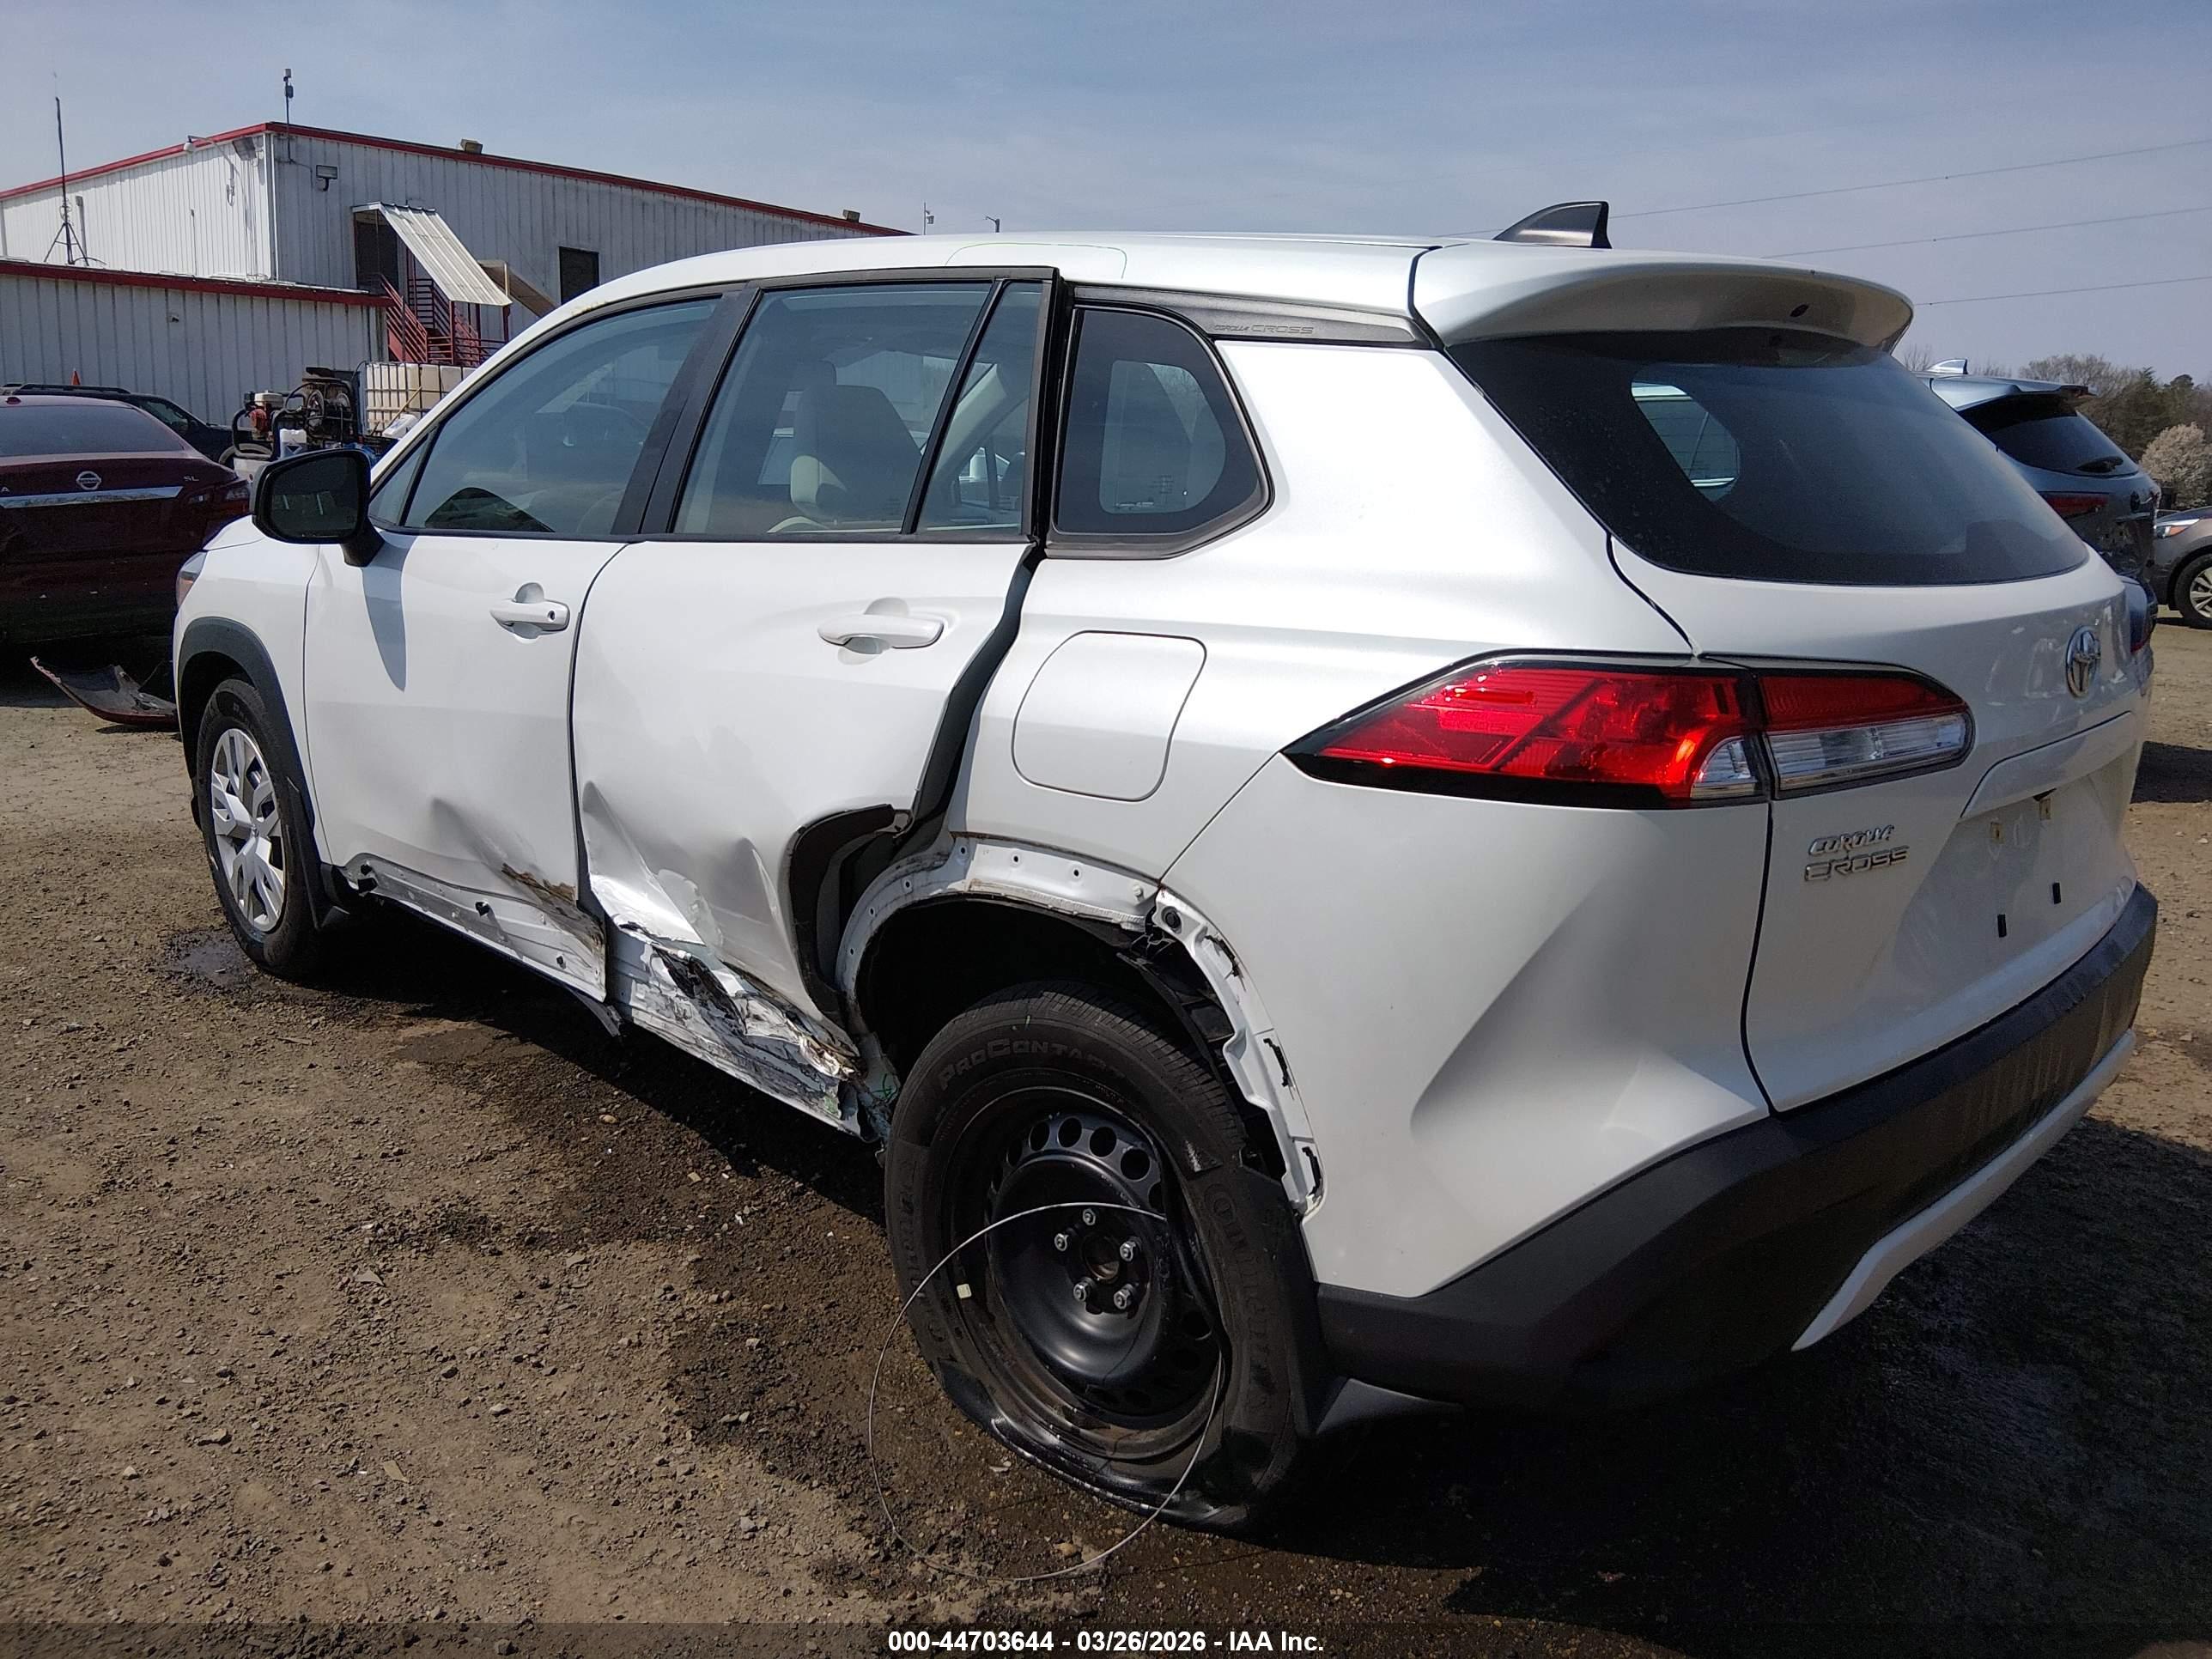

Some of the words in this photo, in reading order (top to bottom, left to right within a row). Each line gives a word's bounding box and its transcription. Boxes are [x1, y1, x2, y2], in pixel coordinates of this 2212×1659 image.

[1251, 325, 1314, 334] CROSS
[1808, 824, 1895, 856] COROLLA
[1804, 845, 1911, 881] CROSS
